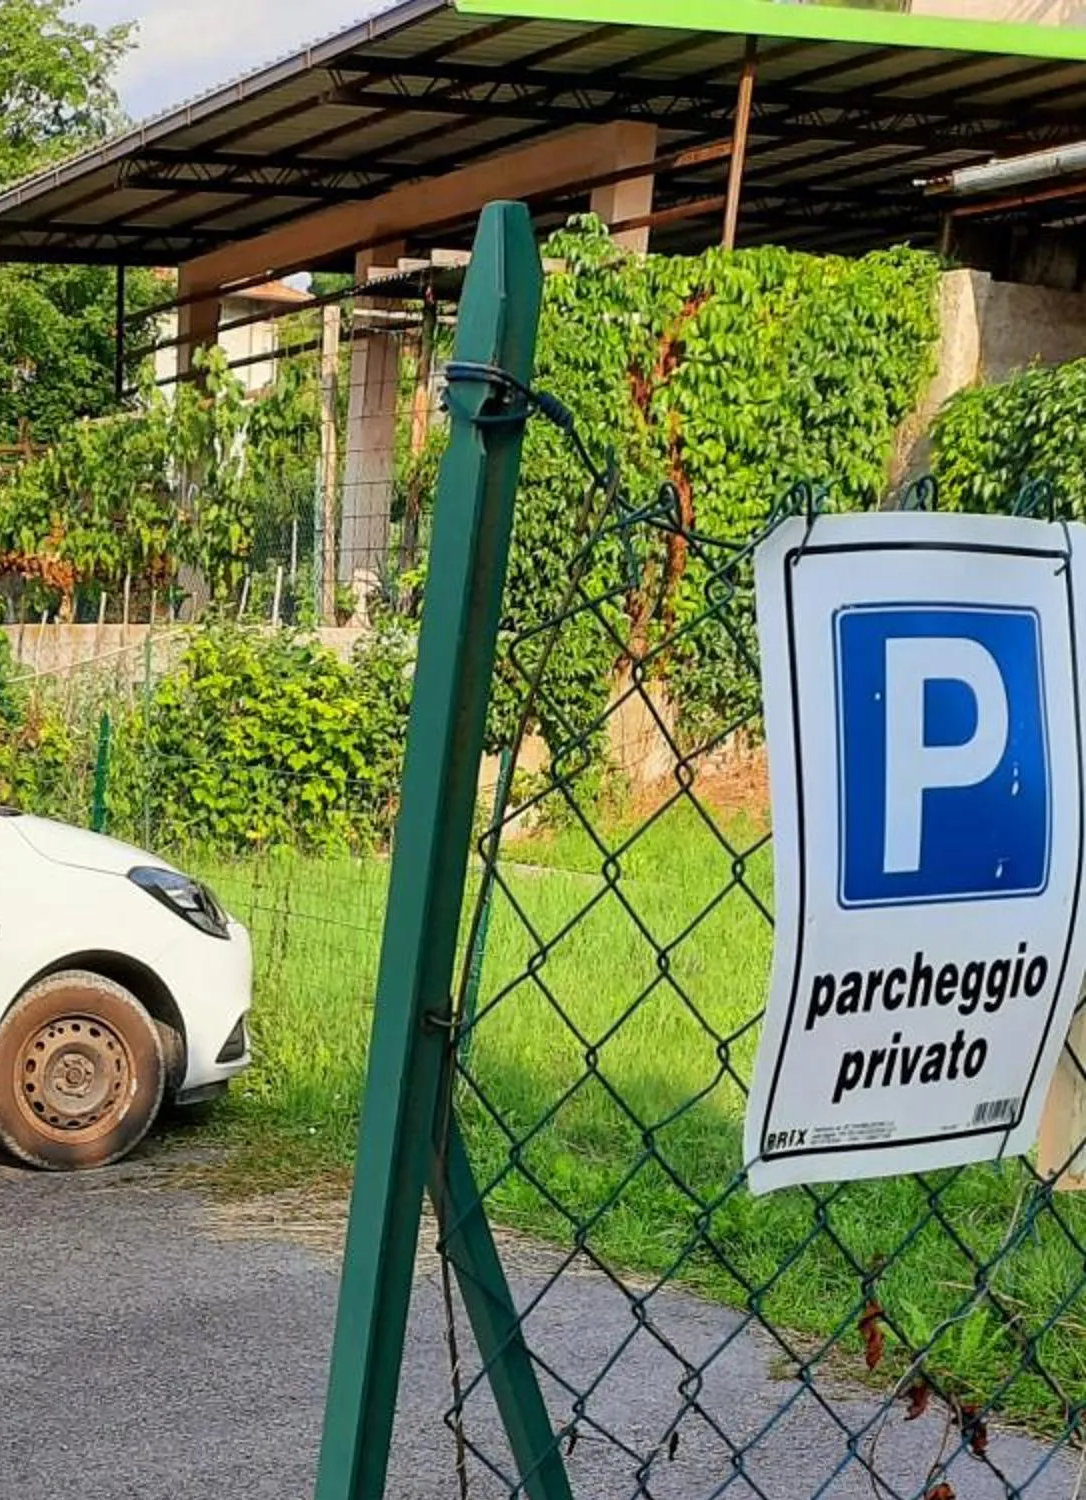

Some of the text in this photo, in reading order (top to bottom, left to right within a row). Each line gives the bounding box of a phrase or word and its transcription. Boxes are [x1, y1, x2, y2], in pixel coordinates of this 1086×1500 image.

[883, 637, 1009, 873] P
[804, 941, 1048, 1031] parcheggio
[832, 1029, 988, 1104] privato
[767, 1129, 808, 1150] BRIX
